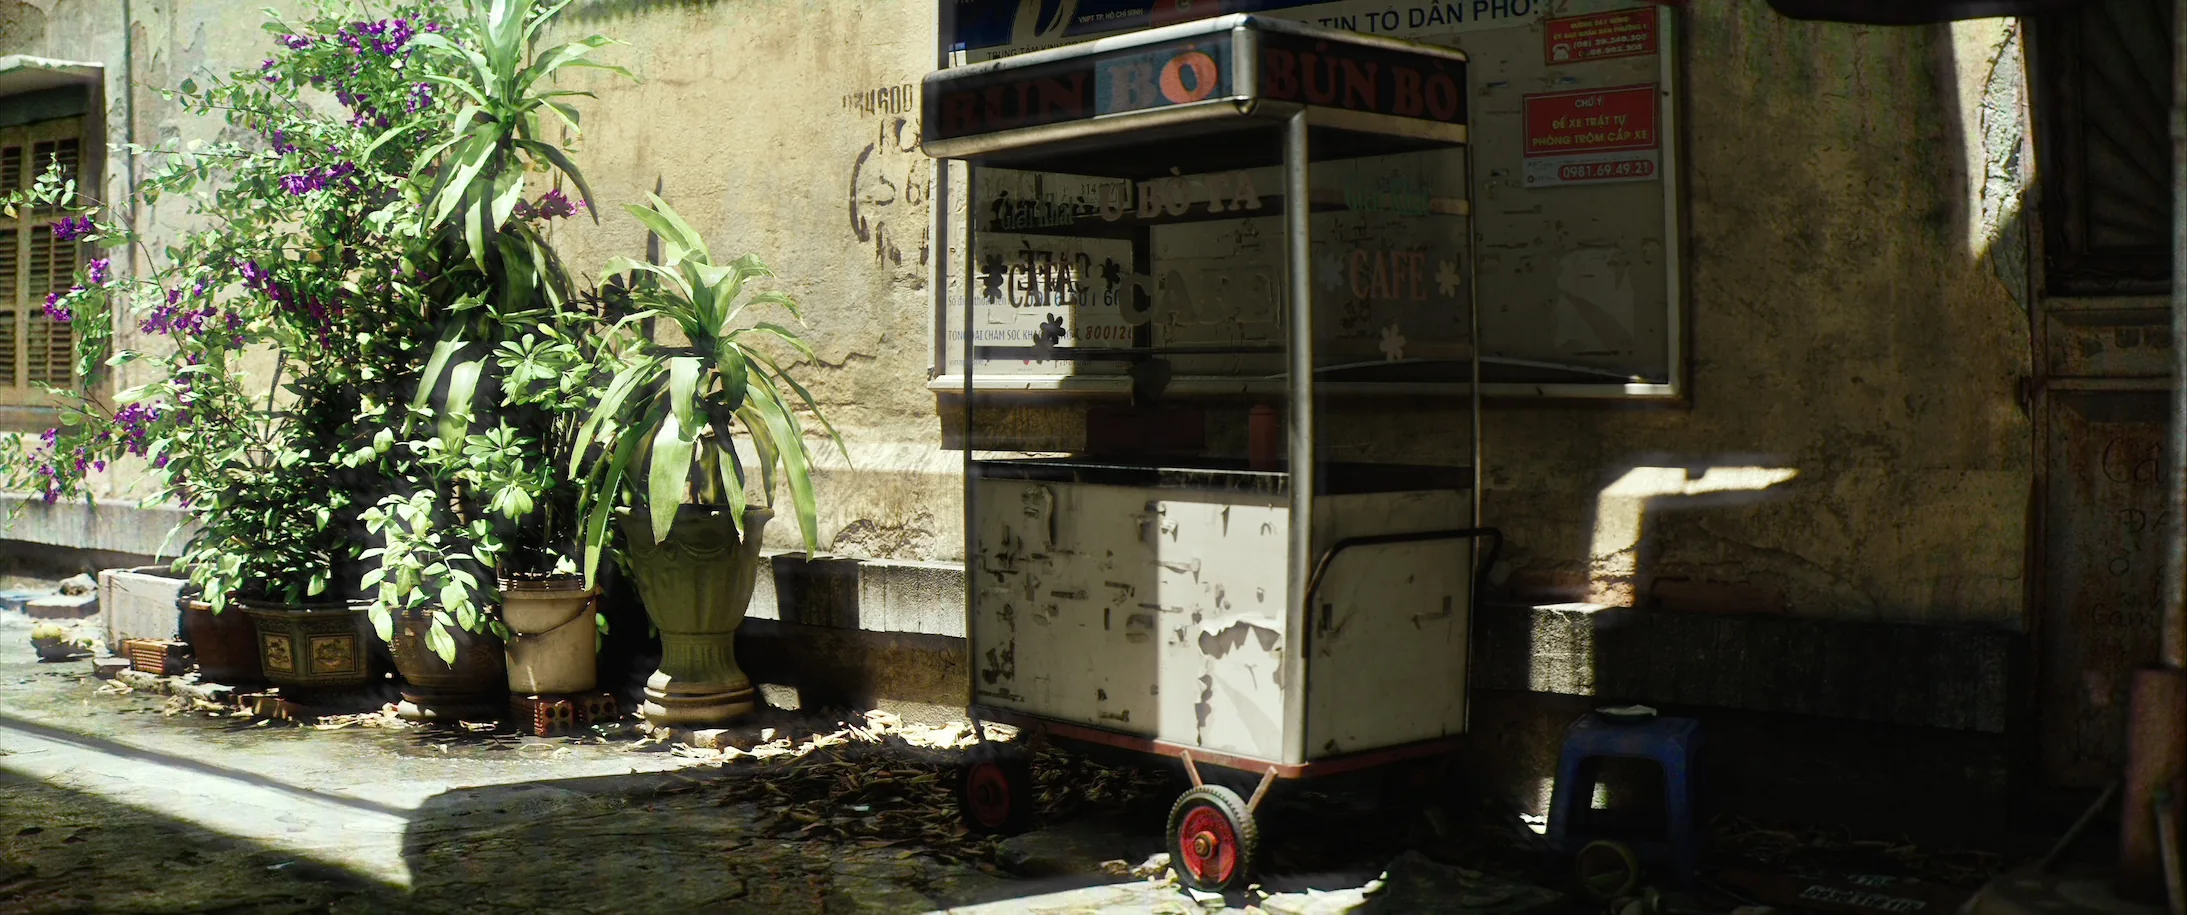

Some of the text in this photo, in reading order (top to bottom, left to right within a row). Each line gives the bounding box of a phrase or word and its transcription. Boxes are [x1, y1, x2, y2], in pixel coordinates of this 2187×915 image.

[1078, 17, 1095, 25] VNPT
[1127, 8, 1144, 17] MINH
[1391, 60, 1459, 120] BÒ
[1568, 117, 1582, 128] XE
[1634, 130, 1648, 140] XE
[1562, 161, 1650, 178] 0981.69.49.21
